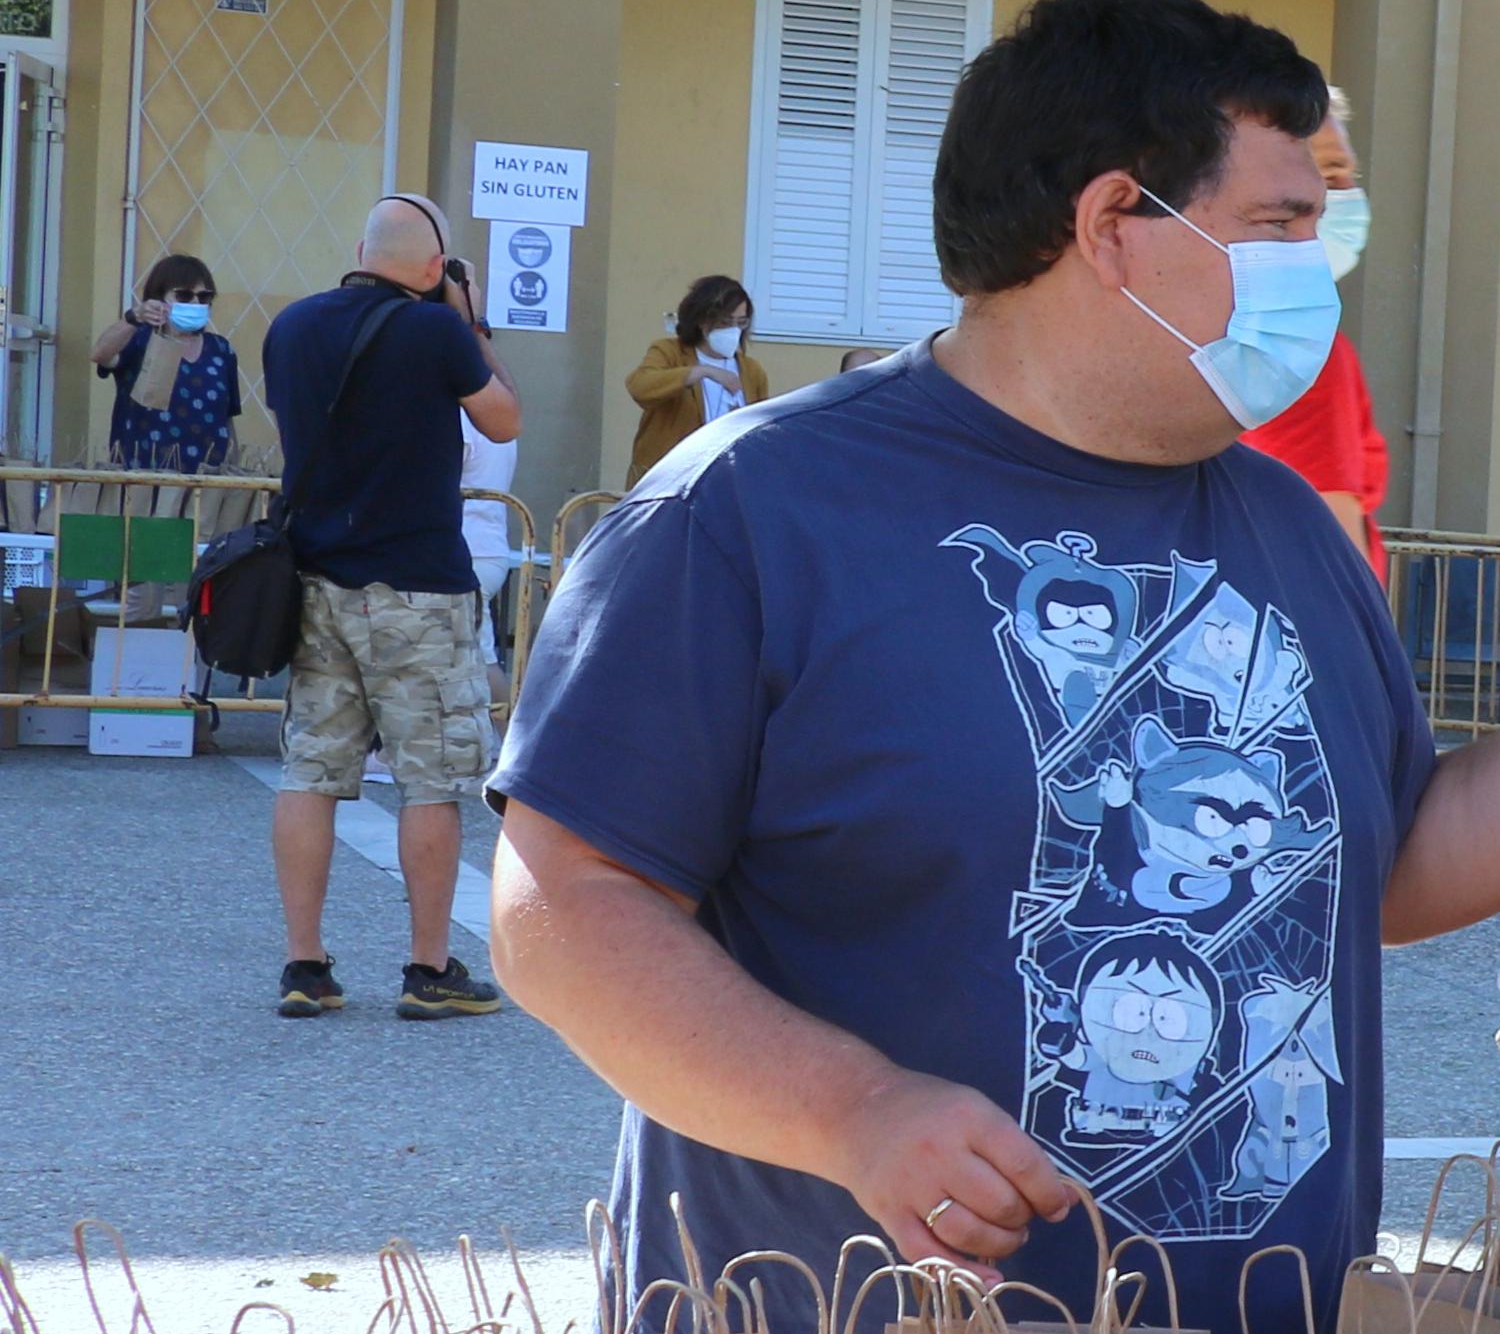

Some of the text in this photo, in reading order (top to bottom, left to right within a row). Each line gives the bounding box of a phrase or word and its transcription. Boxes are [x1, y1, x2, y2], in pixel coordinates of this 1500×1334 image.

[495, 156, 568, 176] HAY PAN
[481, 180, 579, 201] SIN GLUTEN
